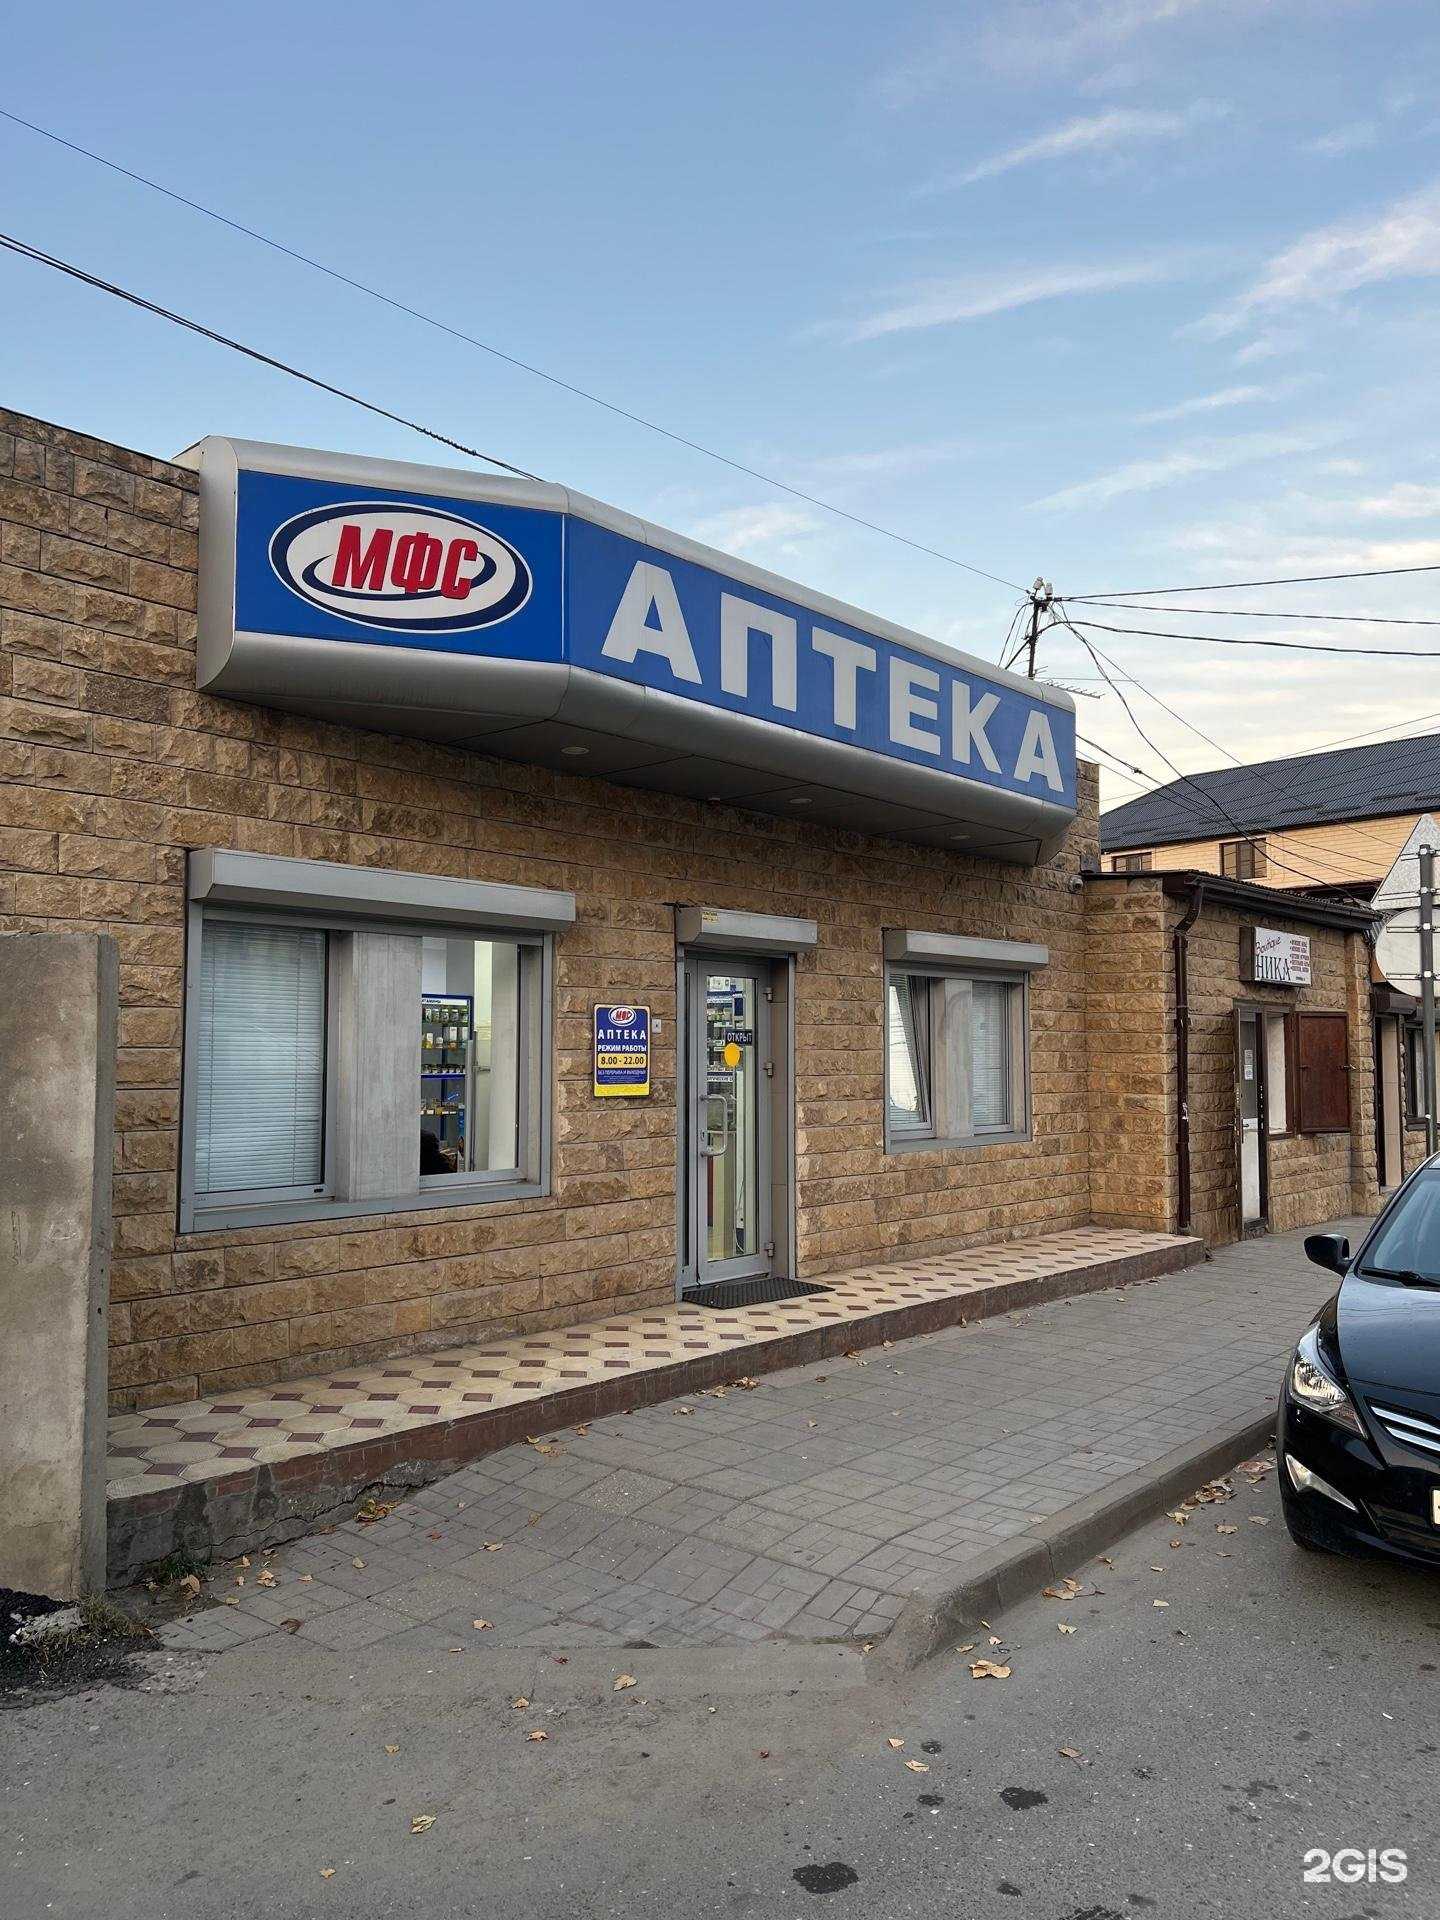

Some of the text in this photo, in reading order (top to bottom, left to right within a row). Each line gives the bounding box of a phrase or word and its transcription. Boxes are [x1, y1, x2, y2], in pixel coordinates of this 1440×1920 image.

[331, 524, 479, 600] МФС
[601, 560, 1064, 793] АПТЕКА
[1256, 954, 1291, 980] НИКА
[597, 1029, 646, 1040] АПТЕКА
[597, 1044, 621, 1052] РЕЖИМ
[601, 1056, 618, 1065] 8.00
[623, 1056, 644, 1065] 22.00
